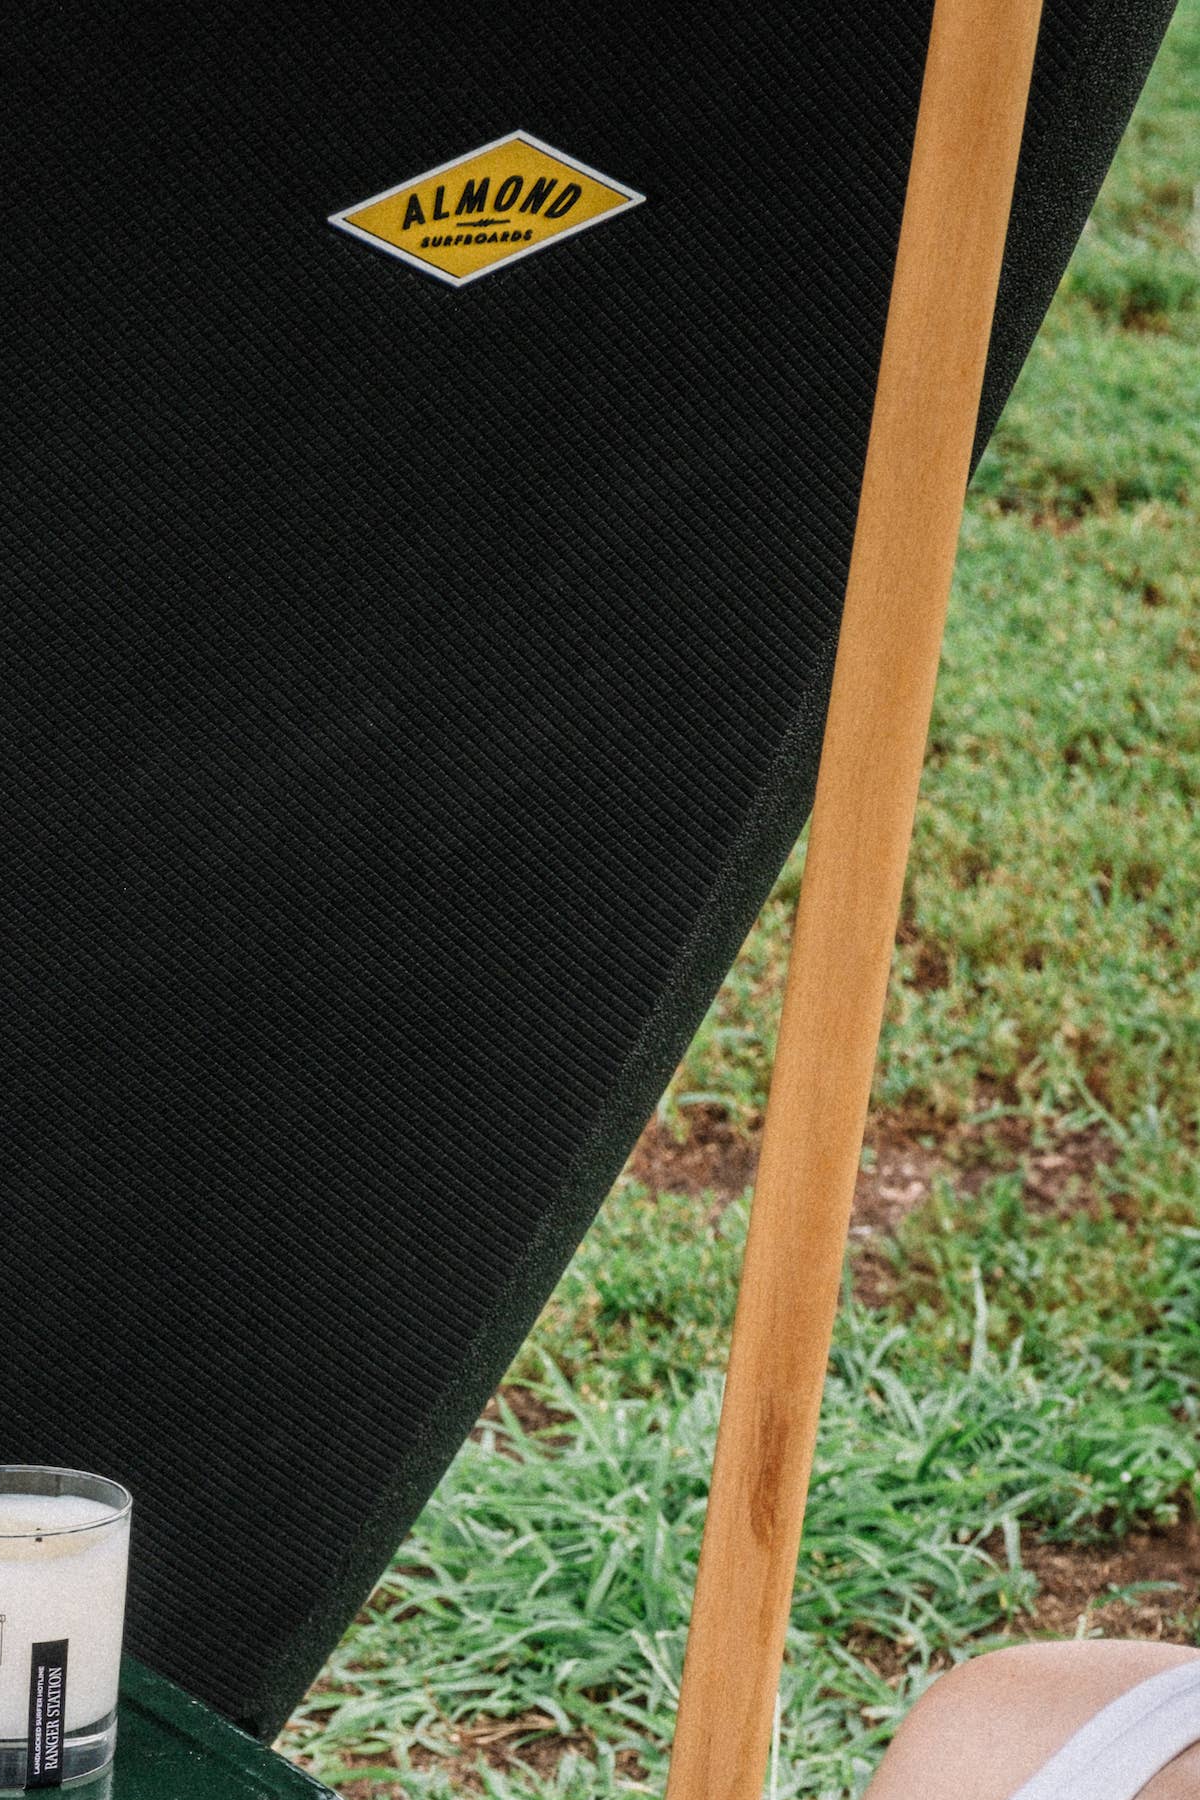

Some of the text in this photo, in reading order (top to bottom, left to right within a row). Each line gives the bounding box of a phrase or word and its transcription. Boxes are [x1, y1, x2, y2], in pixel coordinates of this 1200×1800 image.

[402, 175, 583, 231] ALMOND
[420, 229, 534, 249] SURFBOARDS
[33, 1665, 45, 1775] LANDLOCKED SURFER HOTLINE
[44, 1667, 62, 1771] RANGER STATION
